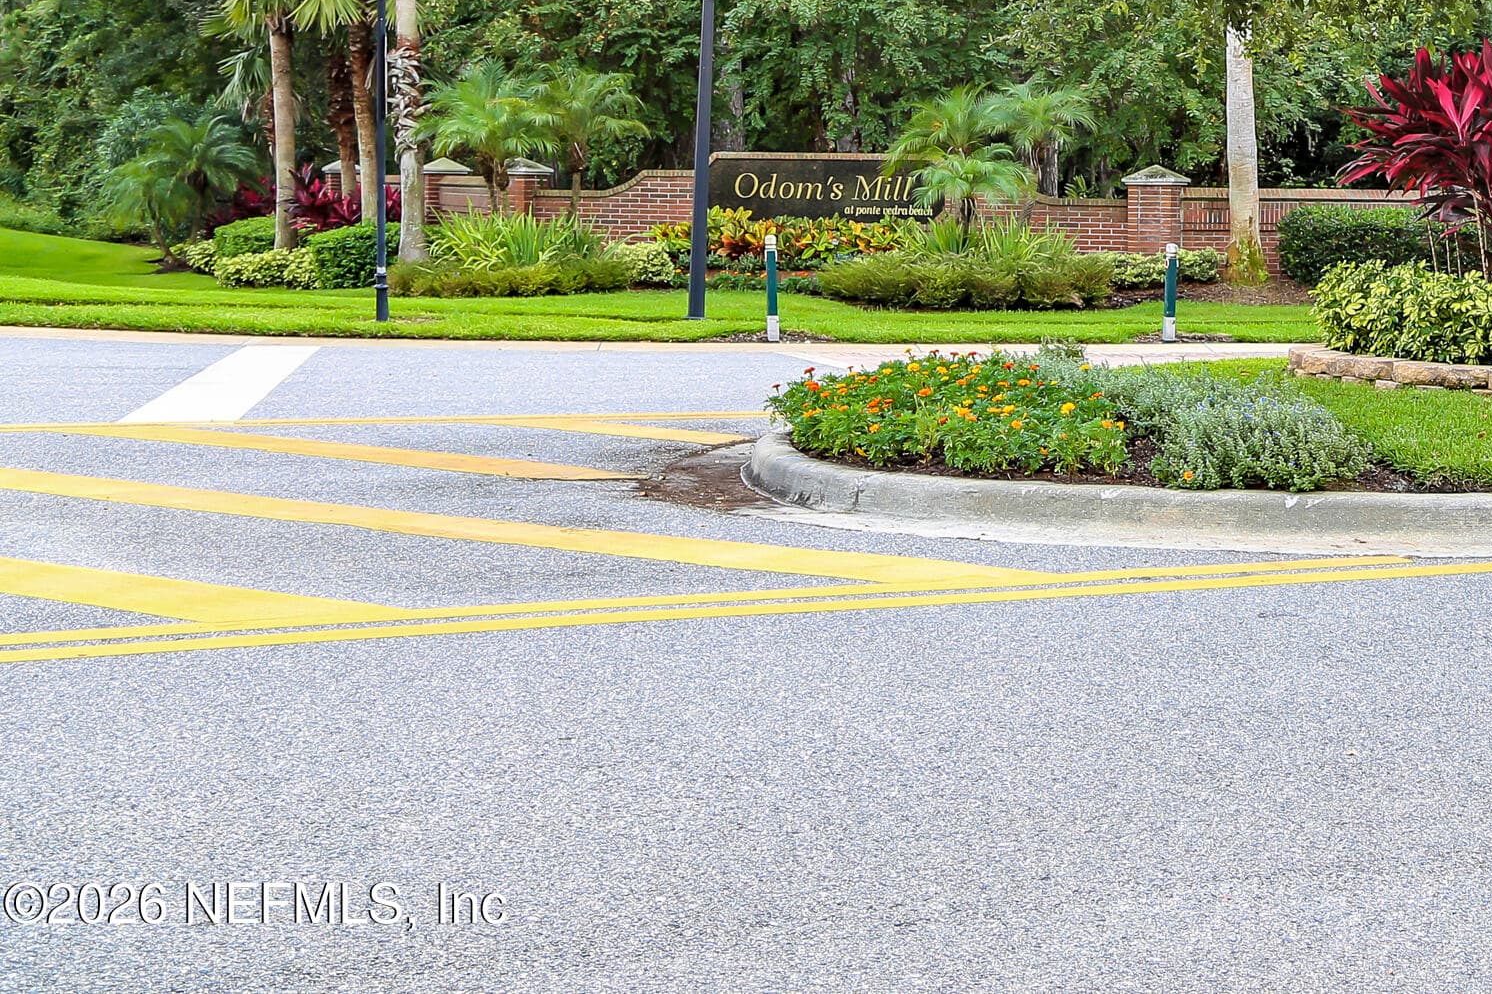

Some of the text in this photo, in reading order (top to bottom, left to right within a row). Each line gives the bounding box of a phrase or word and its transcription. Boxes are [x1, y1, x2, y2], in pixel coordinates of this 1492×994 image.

[734, 172, 912, 201] Odom's Mill
[844, 206, 853, 215] at
[855, 206, 880, 216] ponte
[882, 205, 908, 216] vedra
